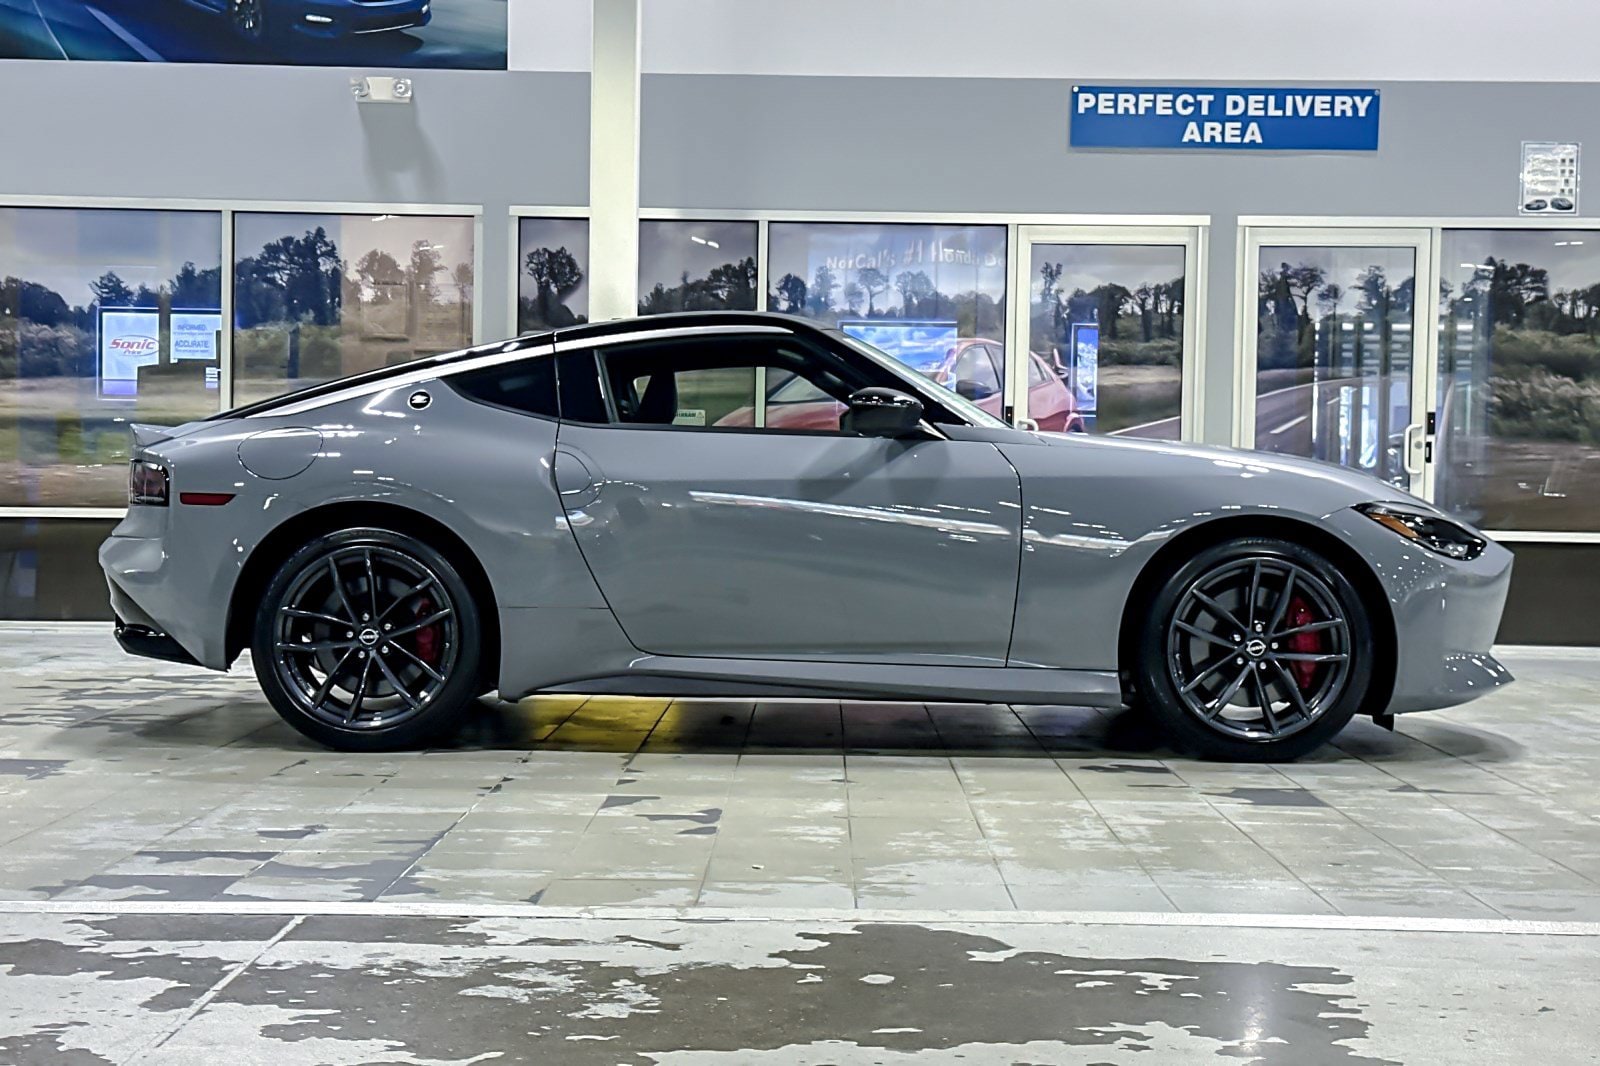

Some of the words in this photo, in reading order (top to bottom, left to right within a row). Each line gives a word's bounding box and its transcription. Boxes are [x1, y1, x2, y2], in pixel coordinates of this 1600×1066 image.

[1077, 93, 1214, 116] PERFECT
[1225, 94, 1372, 117] DELIVERY
[1181, 121, 1263, 143] AREA
[109, 339, 155, 350] Sonic
